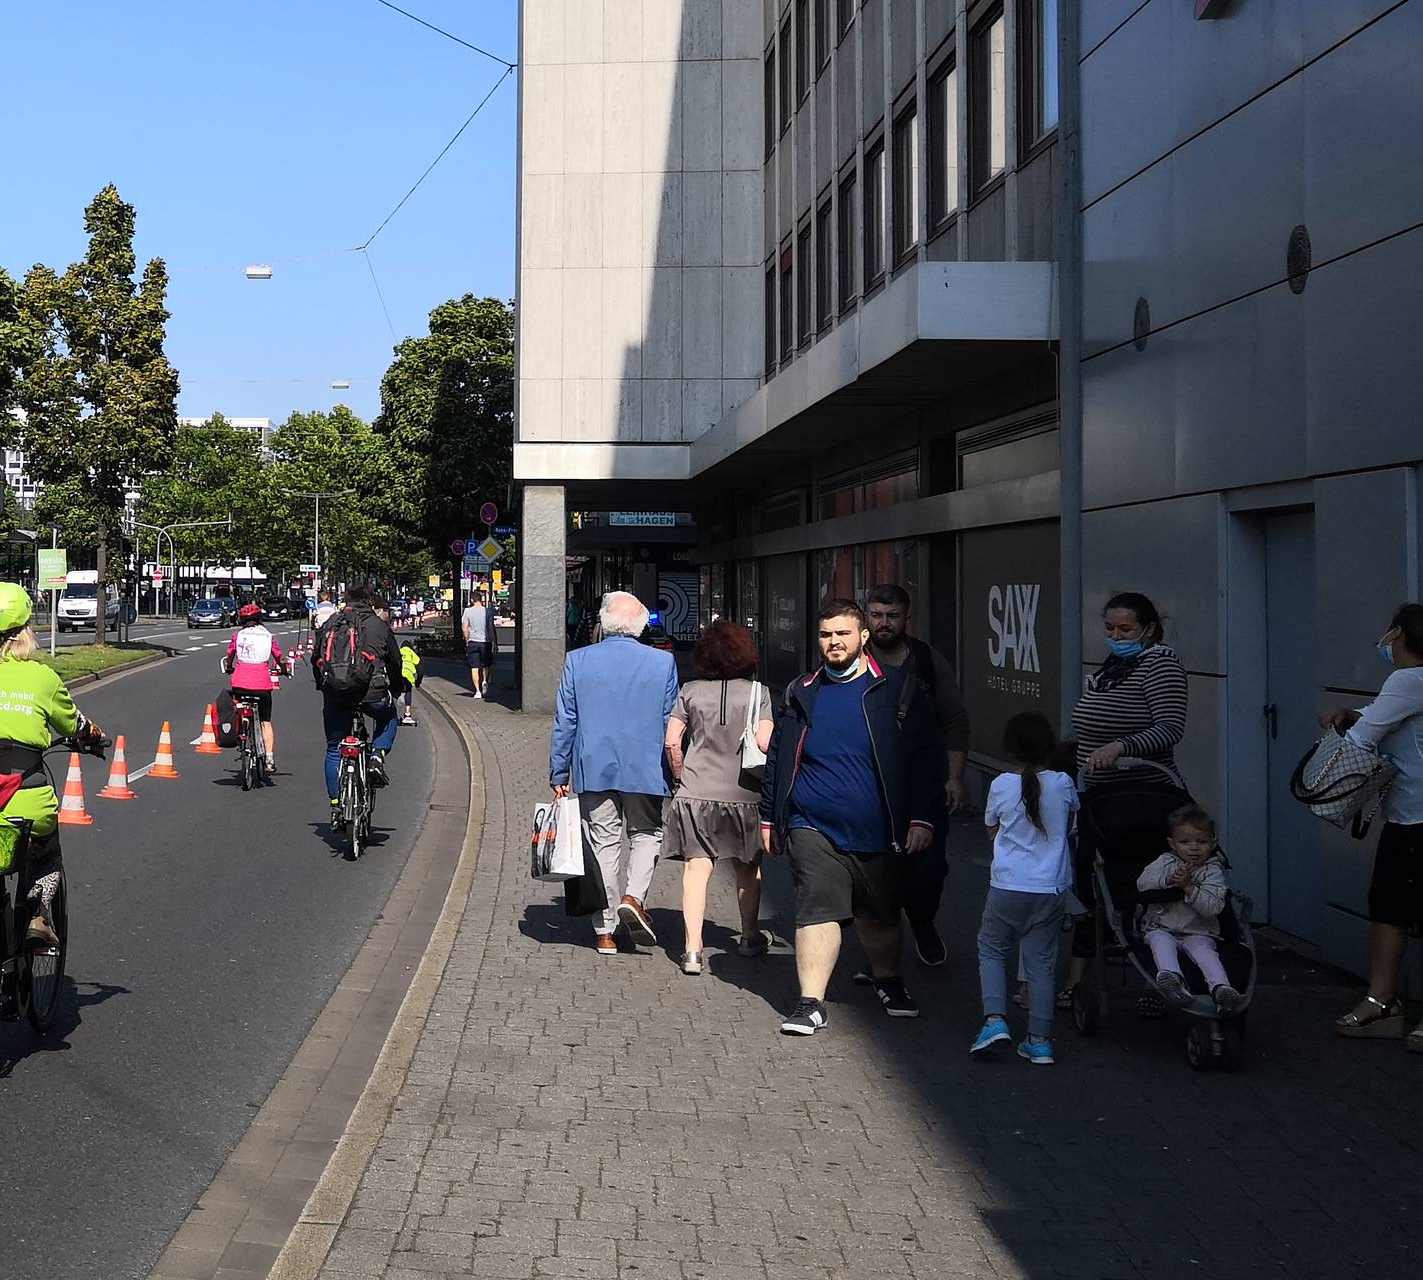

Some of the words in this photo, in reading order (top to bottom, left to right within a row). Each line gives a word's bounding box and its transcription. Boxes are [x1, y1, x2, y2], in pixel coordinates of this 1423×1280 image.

[636, 517, 674, 525] HAGEN
[468, 542, 476, 553] P
[988, 584, 1041, 673] SAXX
[987, 675, 1009, 692] HOTEL
[1011, 679, 1041, 698] GRUPPE
